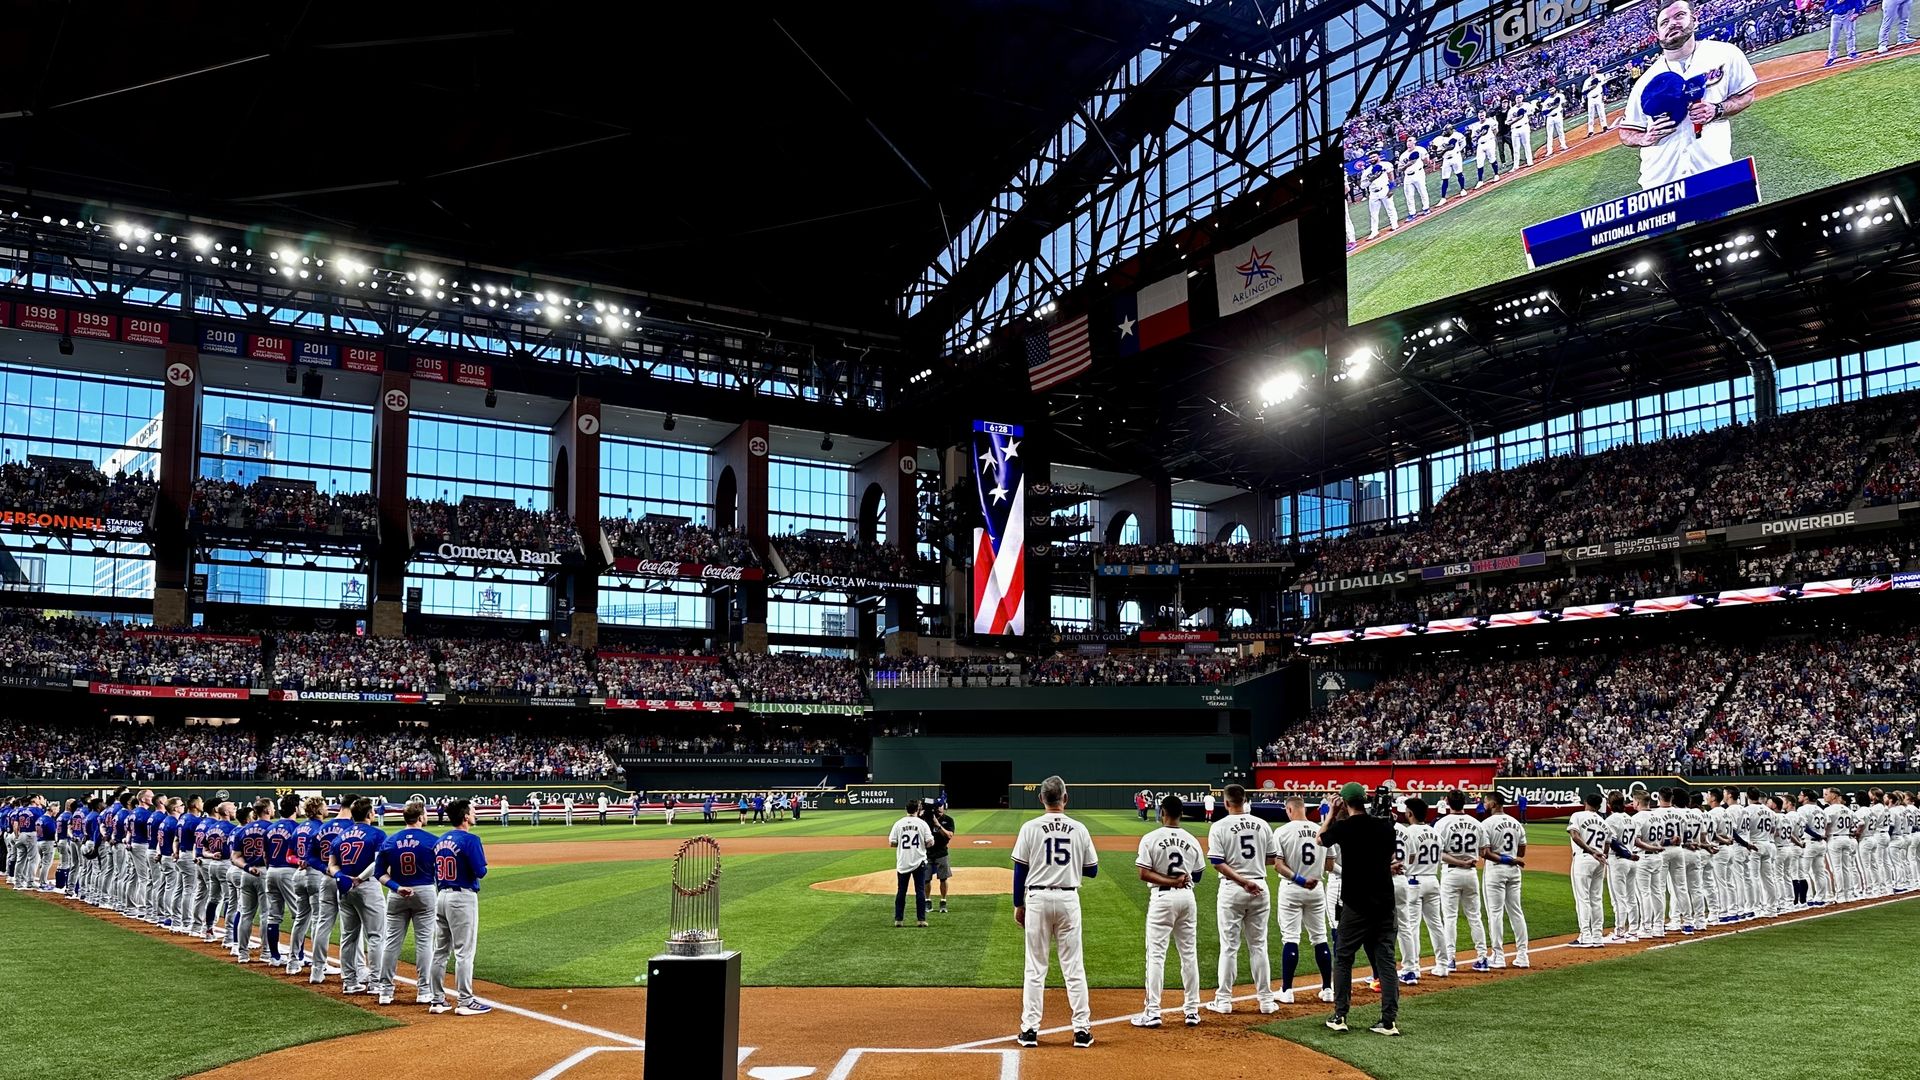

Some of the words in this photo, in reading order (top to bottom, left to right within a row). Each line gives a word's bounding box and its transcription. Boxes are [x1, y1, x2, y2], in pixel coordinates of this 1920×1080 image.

[1580, 199, 1625, 229] WADE
[1627, 181, 1687, 215] BOWEN
[1591, 225, 1636, 247] NATIONAL
[1637, 211, 1677, 233] ANTHEM
[1232, 274, 1284, 304] ARLINGTON
[25, 305, 57, 320] 1998
[21, 322, 59, 332] CHAMPIONS
[78, 313, 109, 327] 1999
[130, 320, 162, 334] 2010
[74, 328, 111, 338] CHAMPIONS
[206, 330, 236, 343] 2010
[127, 336, 163, 345] CHAMPIONS
[257, 336, 283, 350] 2011
[202, 346, 238, 354] CHAMPIONS
[304, 342, 328, 356] 2011
[350, 348, 377, 362] 2012
[252, 352, 286, 361] CHAMPIONS
[298, 358, 332, 366] CHAMPIONS
[416, 358, 442, 370] 2015
[460, 364, 485, 376] 2016
[170, 367, 191, 383] 34
[386, 394, 406, 408] 26
[584, 418, 593, 431] 7
[989, 423, 1008, 434] 6:28
[750, 440, 766, 453] 29
[902, 459, 914, 471] 10
[106, 518, 144, 527] STAFFING
[1761, 512, 1856, 535] POWERADE
[1614, 535, 1680, 549] ShipPGL.com
[1614, 542, 1680, 556] 877.701.1919
[520, 548, 562, 565] Bank
[1576, 545, 1607, 558] PGL
[637, 559, 681, 576] Coca-Cola
[702, 564, 744, 580] Coca-Cola
[1443, 564, 1471, 576] 105.3
[1472, 560, 1494, 571] THE
[1496, 556, 1520, 569] FAN
[800, 572, 867, 588] CHOCTAW
[1314, 580, 1336, 593] UT
[1340, 571, 1406, 590] DALLAS
[1231, 632, 1281, 640] PLUCKERS
[2, 676, 30, 686] SHIFT
[110, 687, 125, 695] FORT
[126, 688, 152, 697] WORTH
[189, 690, 209, 698] FORT
[300, 691, 360, 700] GARDENERS
[362, 692, 394, 701] TRUST
[761, 703, 802, 714] LUXOR
[804, 704, 862, 716] STAFFING
[1283, 780, 1325, 790] State
[1406, 780, 1456, 790] State
[536, 790, 596, 802] CHOCTAW
[1190, 792, 1206, 802] Lif
[1514, 787, 1582, 802] National
[1041, 822, 1074, 835] BOCHY
[1230, 821, 1262, 835] SEAGER
[1450, 822, 1477, 833] CARTER
[1756, 818, 1772, 832] 46
[1814, 816, 1825, 830] 33
[1837, 816, 1850, 829] 30
[1298, 830, 1318, 839] JUNG
[1622, 828, 1636, 846] 67
[1649, 826, 1664, 842] 66
[1664, 822, 1680, 838] 61
[1780, 826, 1792, 840] 39
[901, 834, 920, 850] 24
[1418, 832, 1438, 843] DURAN
[1450, 833, 1477, 853] 32
[1503, 832, 1514, 852] 3
[1586, 828, 1606, 849] 72
[242, 838, 264, 857] 29
[272, 838, 283, 859] 7
[297, 836, 306, 858] 5
[1044, 838, 1072, 866] 15
[1158, 838, 1191, 852] SEMIEN
[1240, 834, 1256, 860] 5
[340, 841, 365, 866] 27
[1301, 842, 1316, 866] 6
[1418, 844, 1440, 865] 20
[400, 852, 417, 876] 8
[436, 856, 457, 881] 30
[1167, 852, 1184, 877] 2
